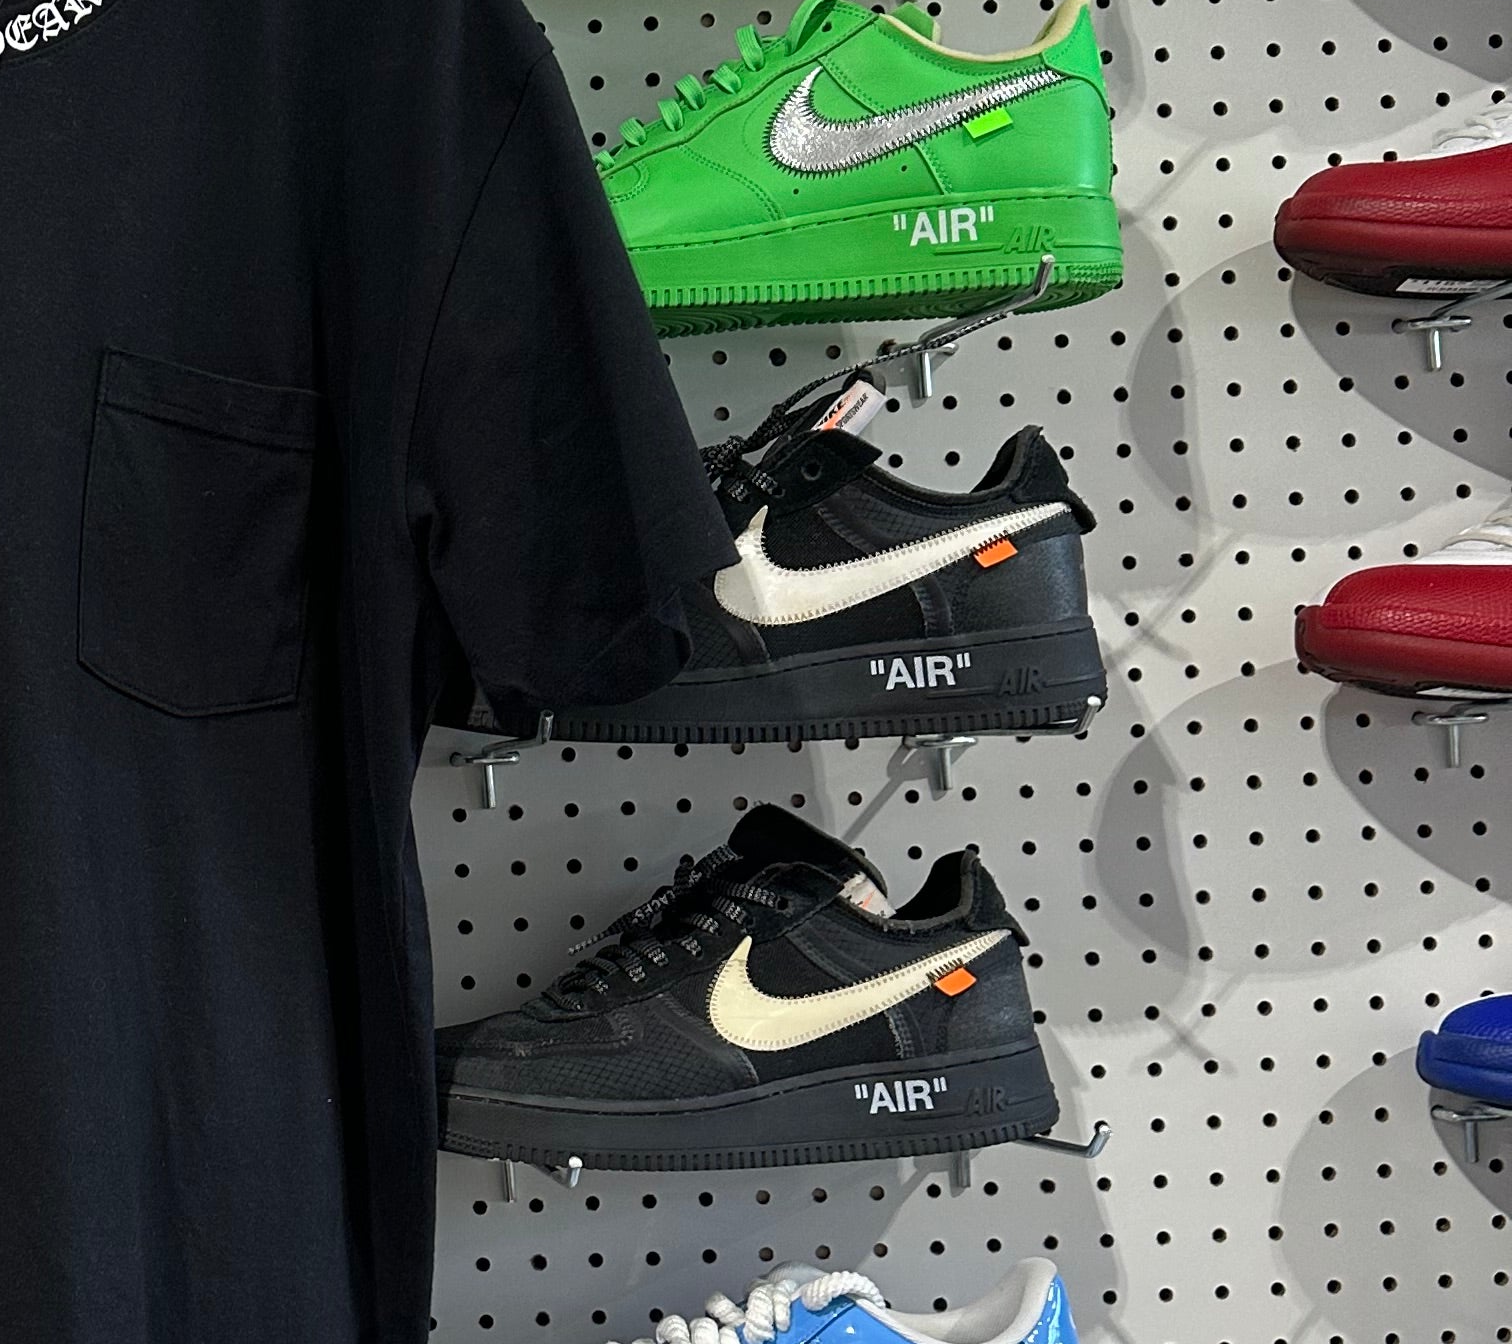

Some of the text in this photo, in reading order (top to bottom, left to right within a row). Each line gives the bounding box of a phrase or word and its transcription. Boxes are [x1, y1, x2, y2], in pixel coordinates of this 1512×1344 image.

[893, 205, 1055, 254] "AIR" AIR
[870, 652, 1046, 697] "AIR" AIR
[854, 1076, 1009, 1117] "AIR" AIR
